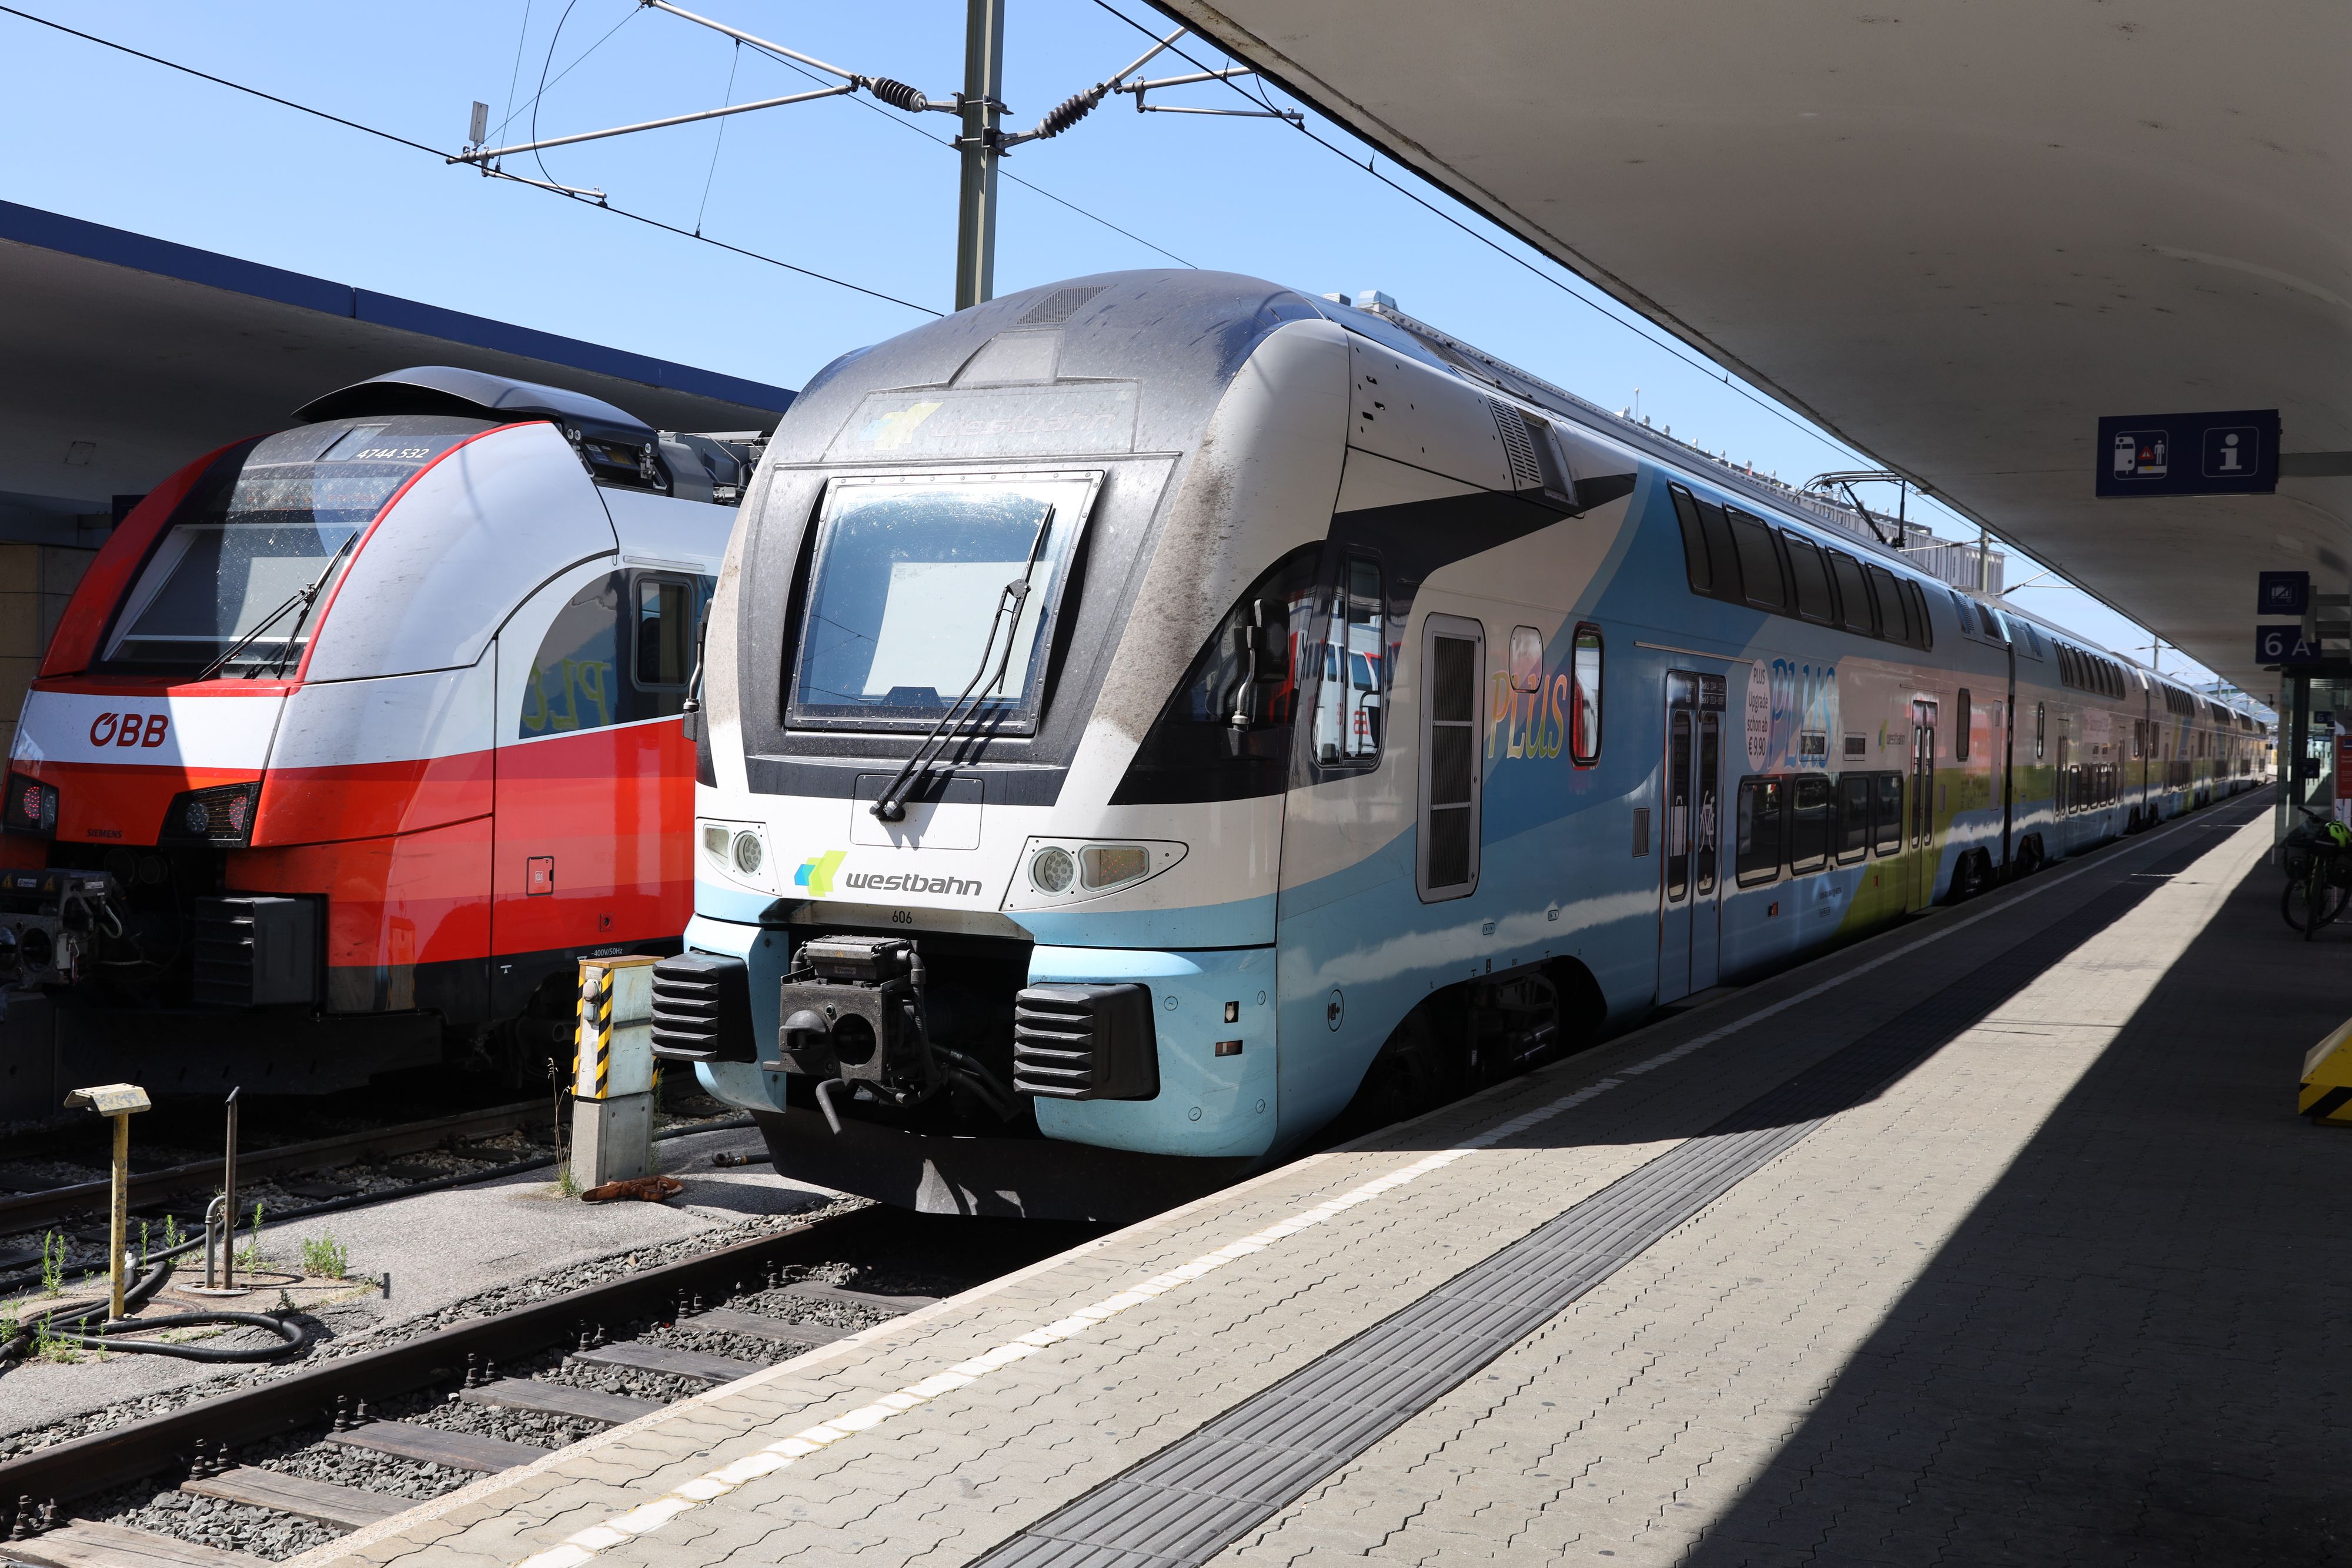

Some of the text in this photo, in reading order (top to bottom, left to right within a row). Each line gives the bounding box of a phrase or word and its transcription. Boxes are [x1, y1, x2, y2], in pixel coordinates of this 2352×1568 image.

[356, 448, 430, 459] 4744 532
[2264, 632, 2311, 656] 6 A
[1753, 667, 1766, 685] PLUS
[1749, 691, 1769, 714] Upgrade
[1766, 656, 1836, 770] PLUS
[1488, 670, 1568, 760] PLUS
[1747, 716, 1768, 735] schon ab
[89, 712, 169, 749] ÖBB
[1753, 736, 1766, 760] 9,90
[86, 828, 123, 838] SIEMENS
[846, 872, 983, 897] westbahn
[892, 910, 913, 924] 606
